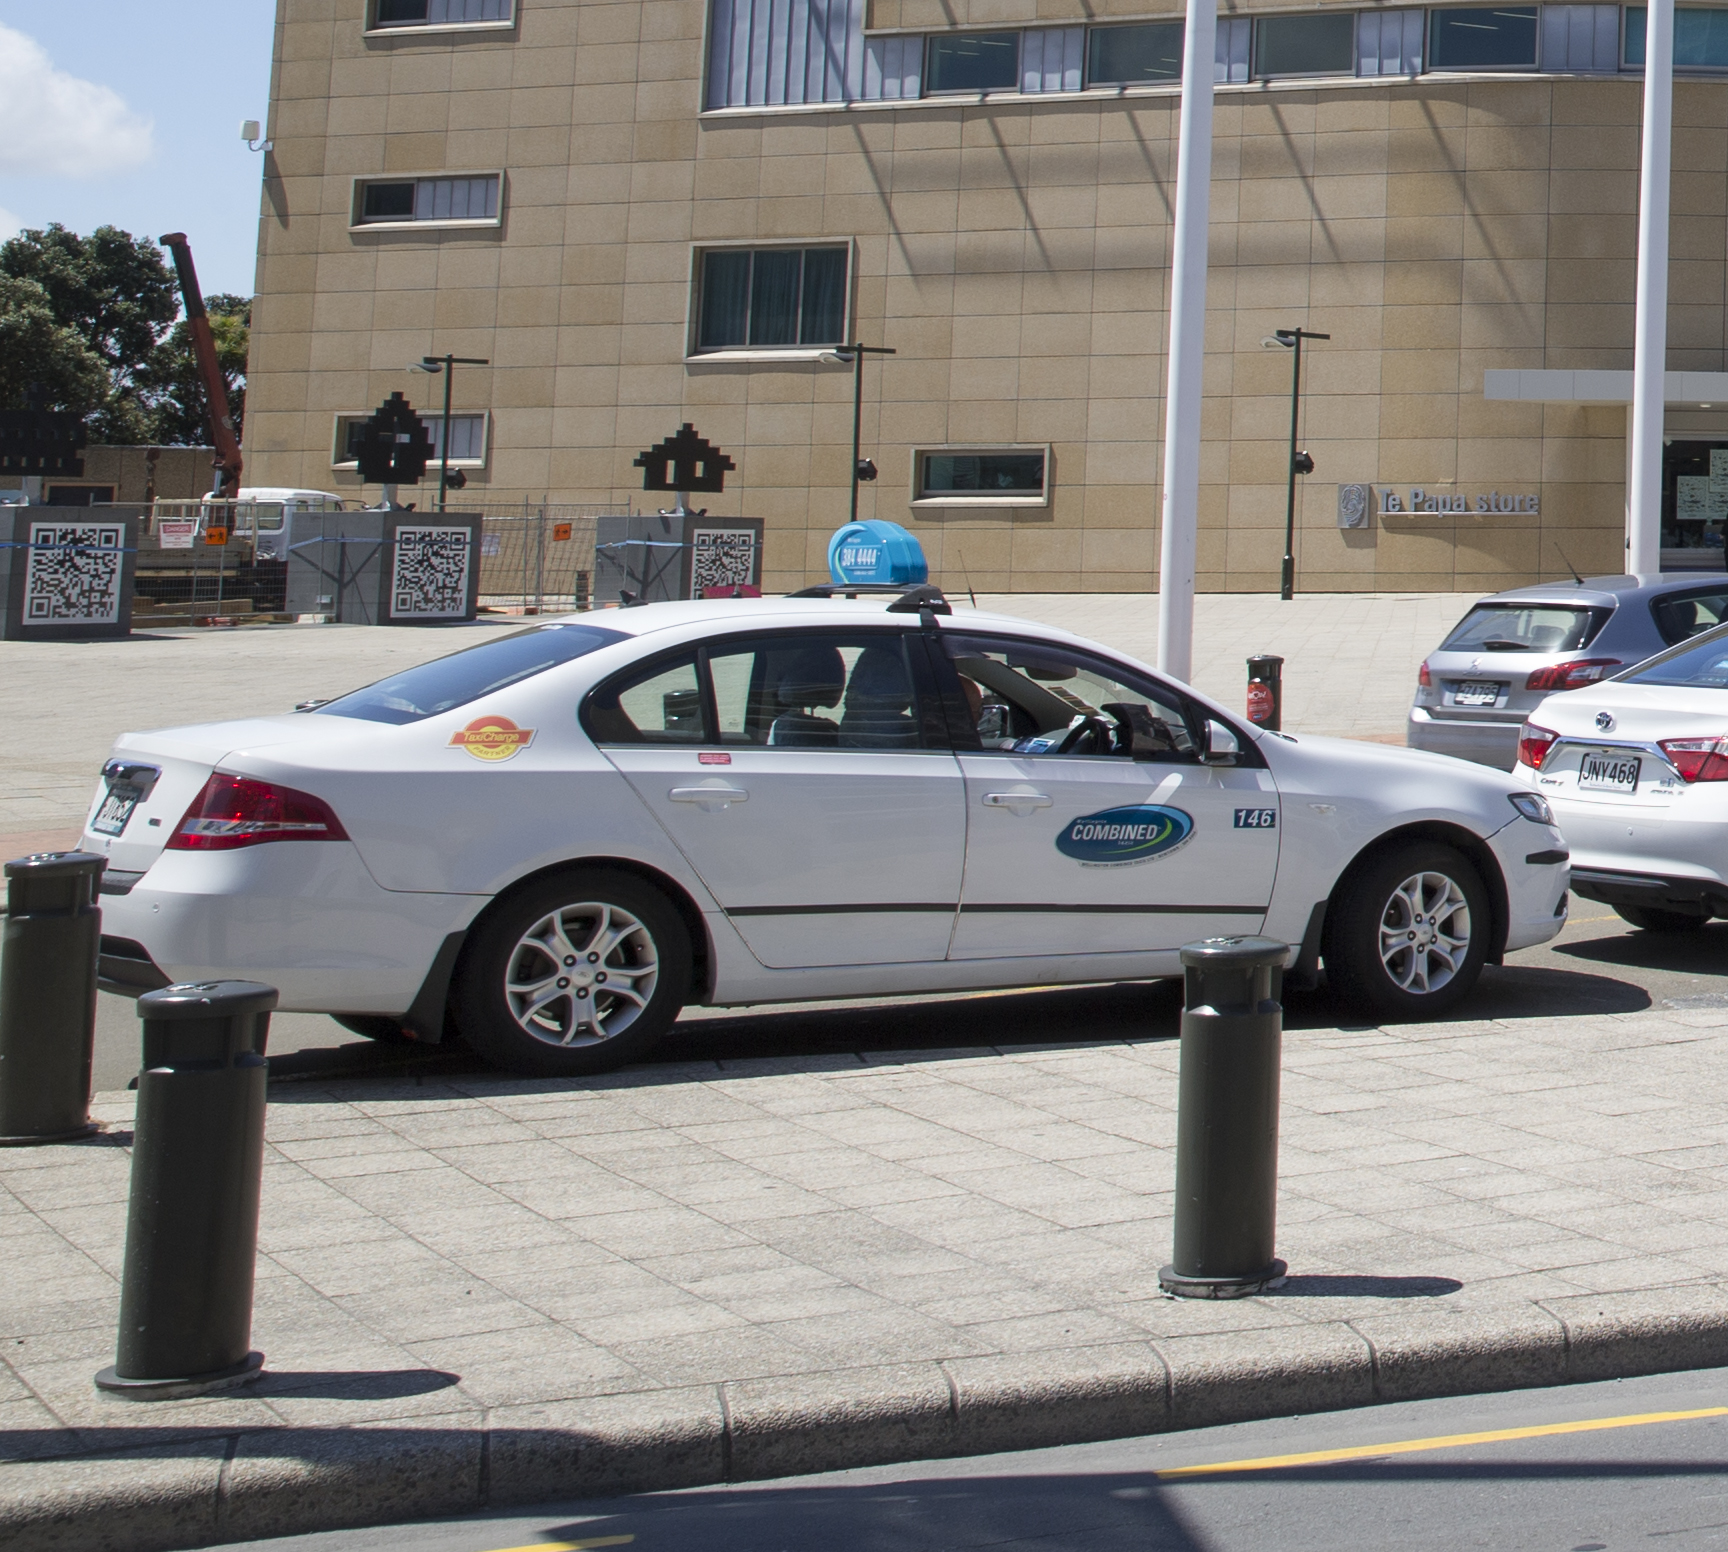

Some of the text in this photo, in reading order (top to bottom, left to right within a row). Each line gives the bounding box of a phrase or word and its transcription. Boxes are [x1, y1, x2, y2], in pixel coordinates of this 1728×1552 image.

[1377, 488, 1539, 518] Te Papa store
[841, 547, 878, 567] 384 4444
[463, 731, 520, 743] TaxiCharge
[473, 745, 511, 757] PARTNER
[1582, 760, 1636, 784] JNY468
[1237, 809, 1272, 827] 146
[1071, 824, 1158, 840] COMBINED
